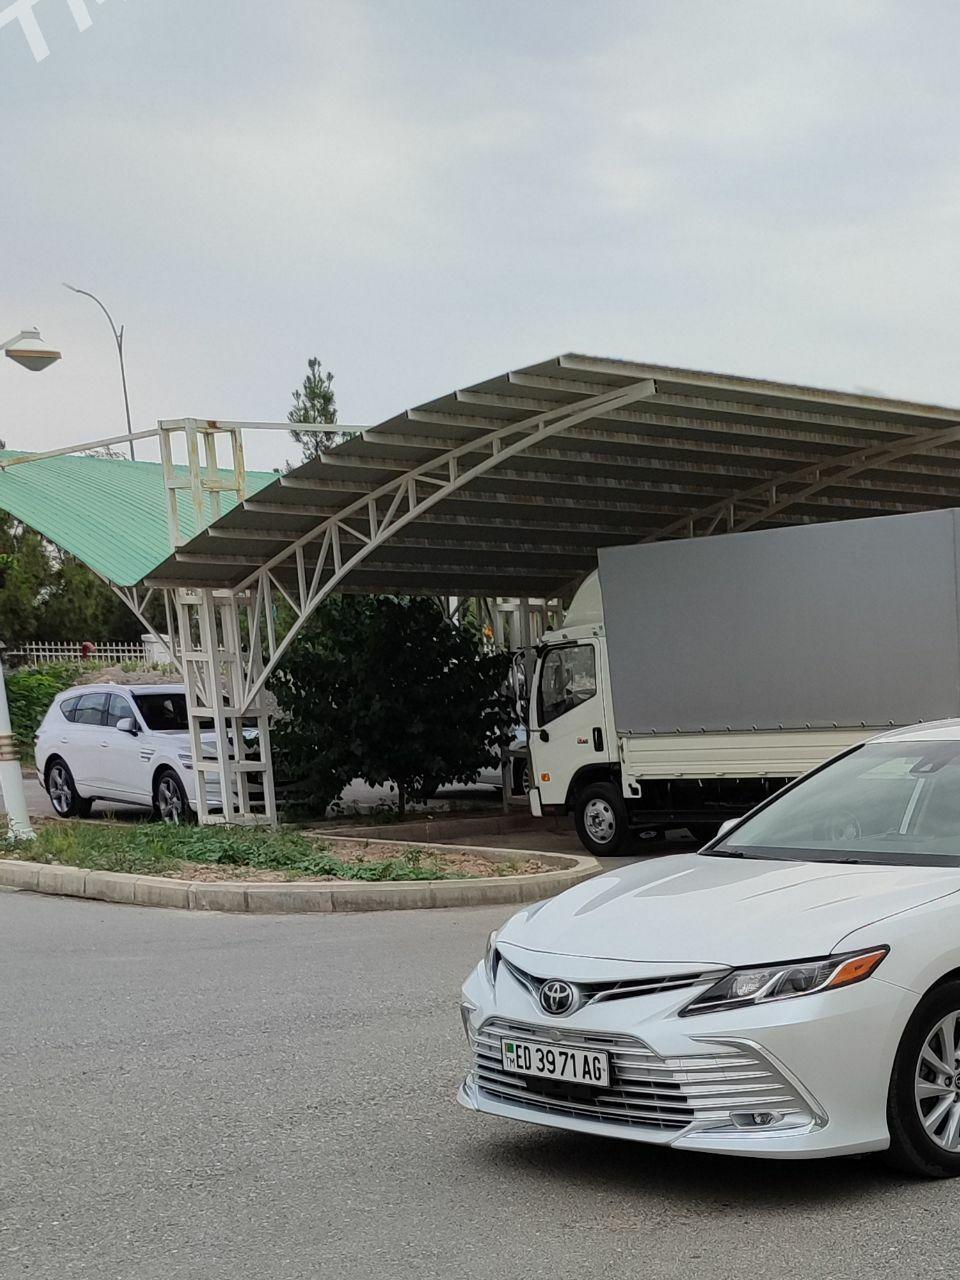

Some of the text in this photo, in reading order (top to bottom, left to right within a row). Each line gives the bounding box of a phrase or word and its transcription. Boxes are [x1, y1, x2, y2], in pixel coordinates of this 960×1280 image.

[506, 1056, 515, 1068] TM
[515, 1044, 601, 1080] ED 3971 AG
